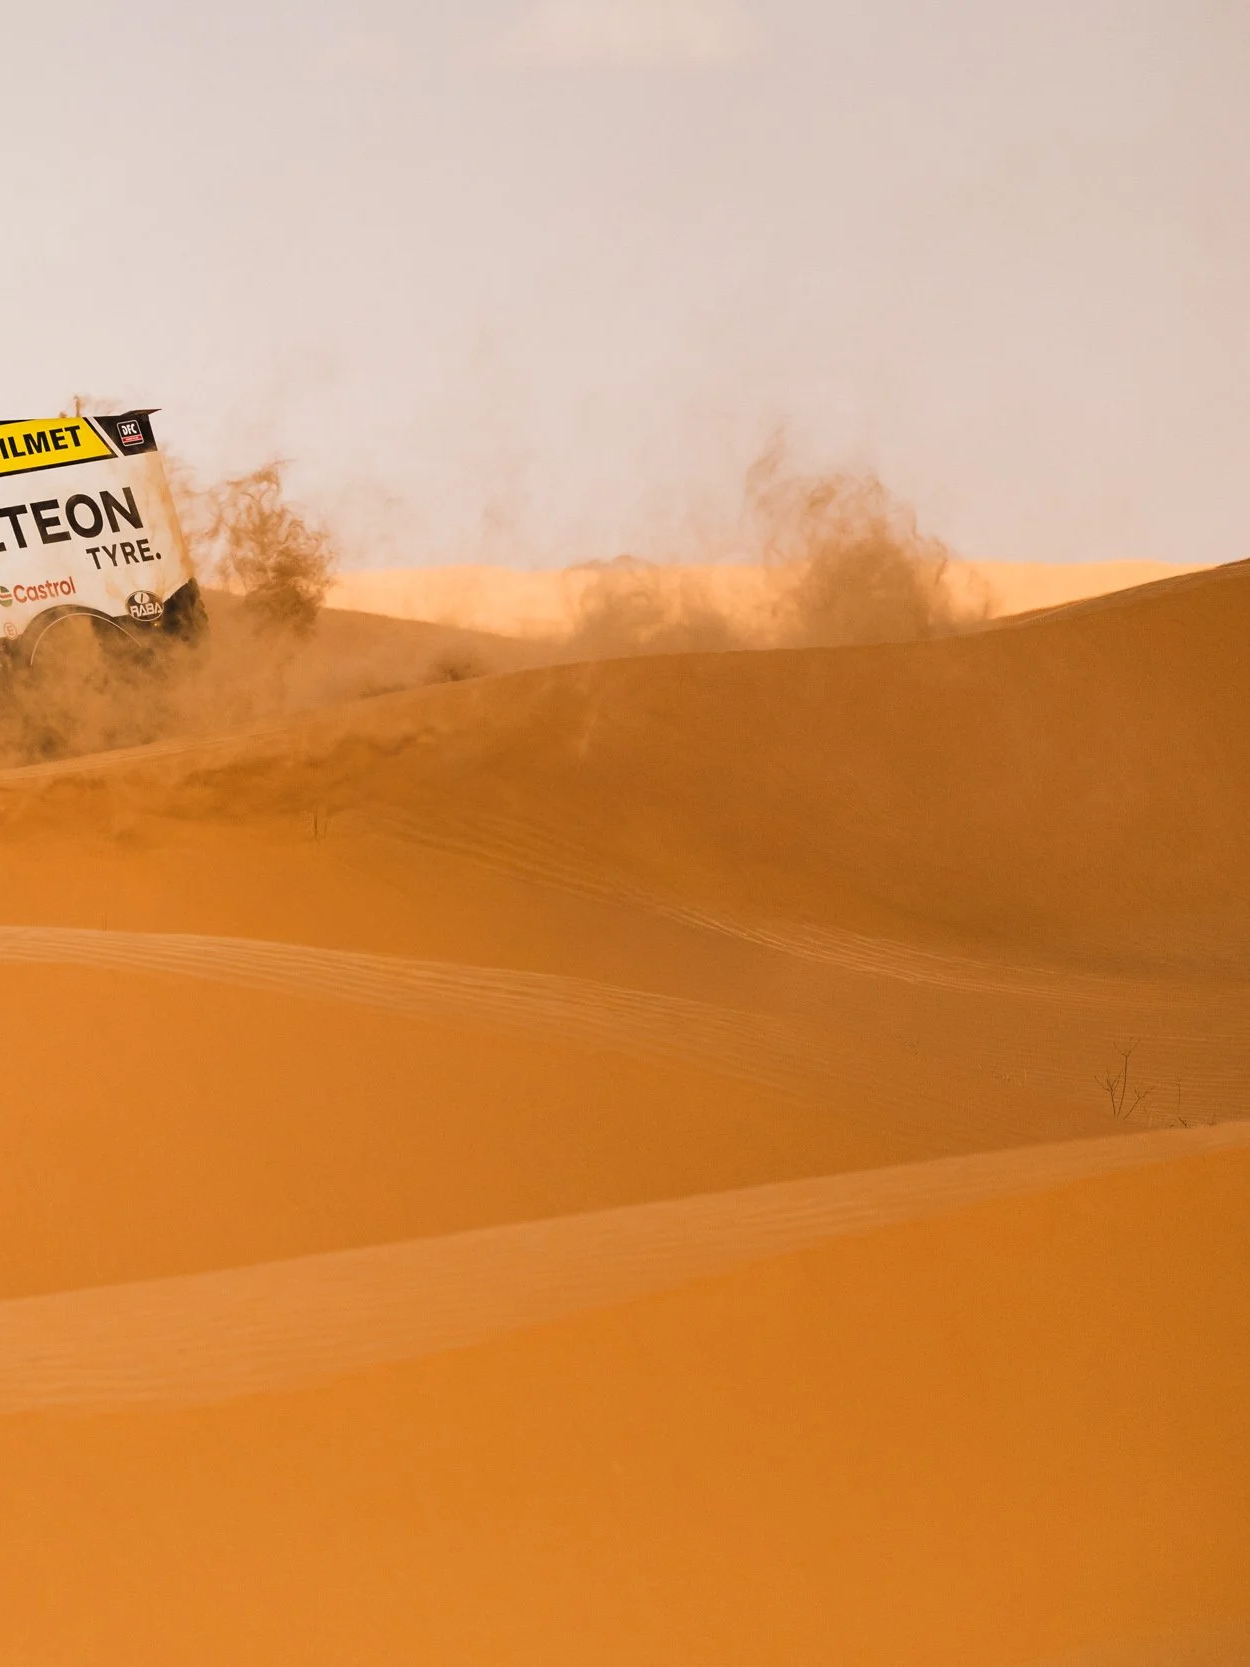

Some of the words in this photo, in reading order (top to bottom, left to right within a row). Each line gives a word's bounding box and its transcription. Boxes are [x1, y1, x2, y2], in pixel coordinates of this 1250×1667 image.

[121, 423, 138, 436] DFC
[86, 538, 162, 570] TYRE.
[13, 575, 77, 603] Castrol
